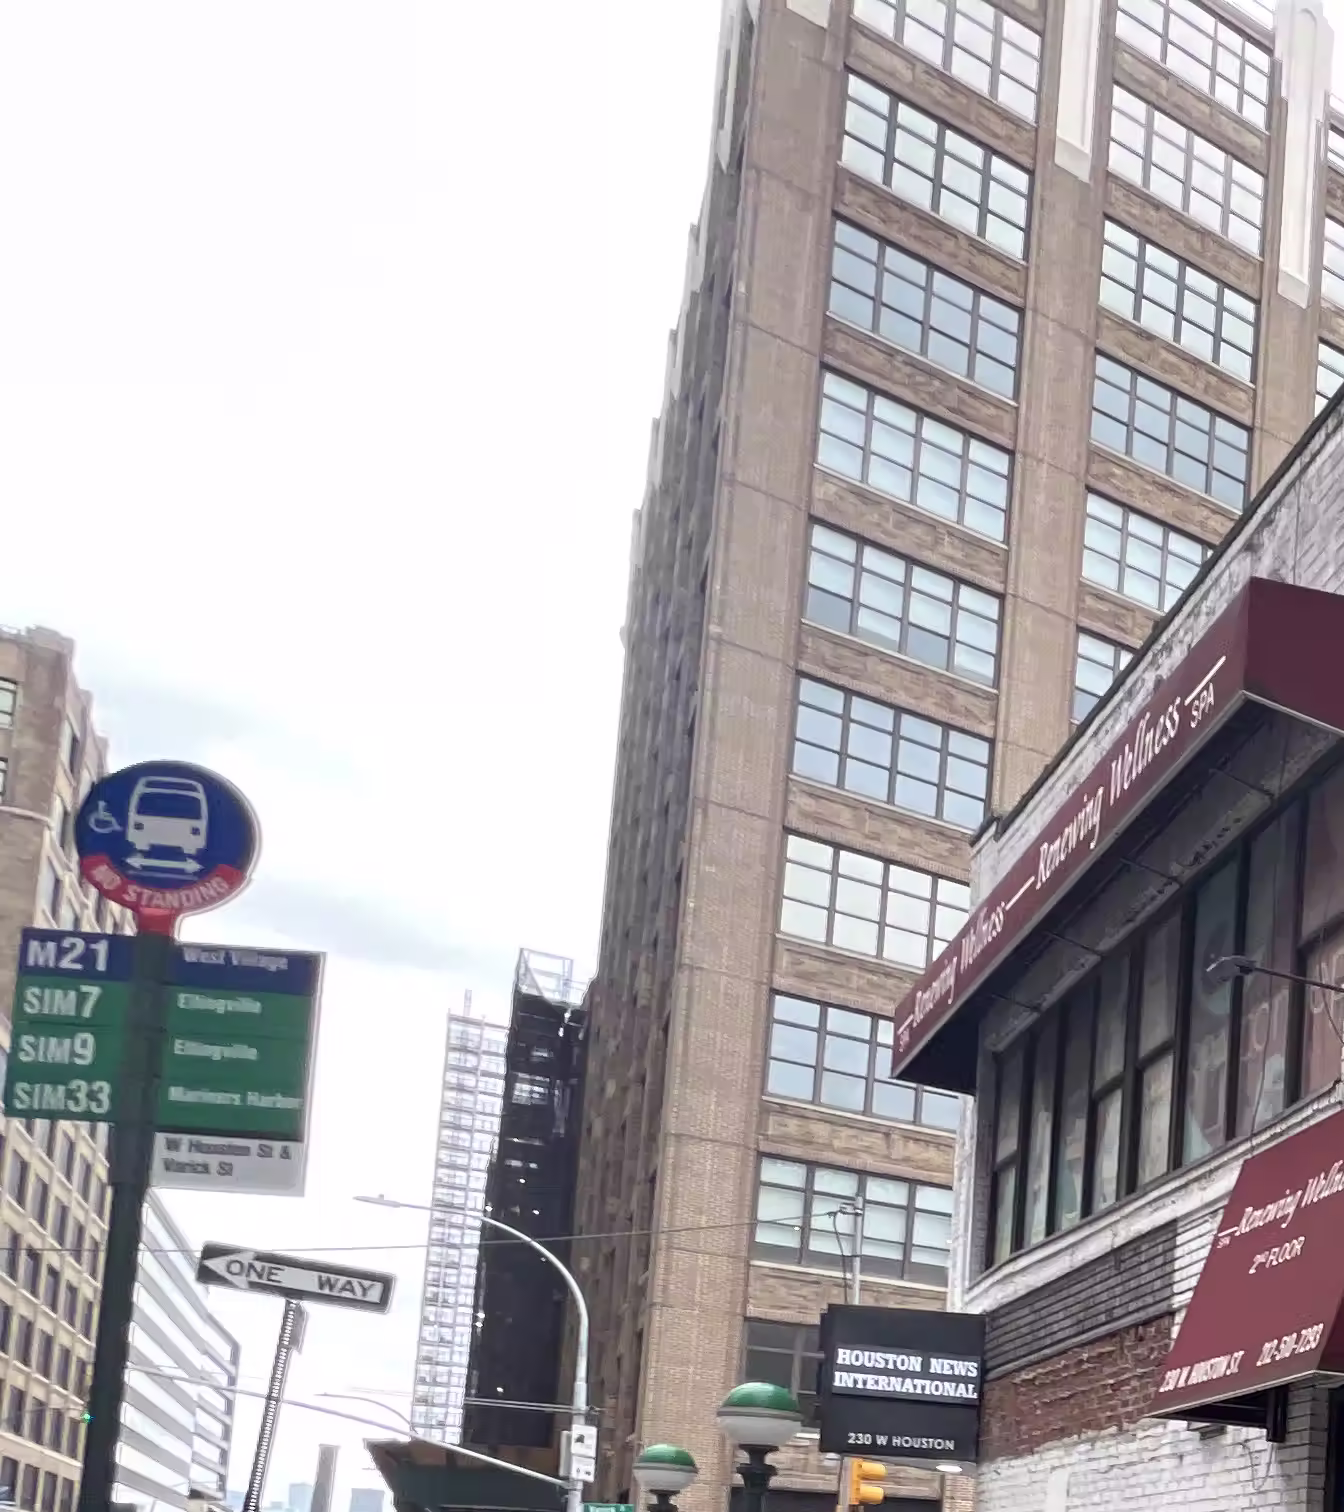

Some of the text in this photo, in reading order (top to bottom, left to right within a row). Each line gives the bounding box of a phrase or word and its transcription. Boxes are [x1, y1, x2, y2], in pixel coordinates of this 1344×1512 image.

[1190, 682, 1214, 728] SPA
[1036, 696, 1181, 889] Renewing Wellness
[122, 876, 229, 908] STANDING
[26, 937, 109, 972] M21
[23, 984, 102, 1018] SIM7
[18, 1032, 95, 1065] SIM9
[13, 1079, 111, 1114] SIM33
[1264, 1236, 1306, 1268] FLOOR
[226, 1259, 376, 1299] ONE WAY
[836, 1348, 978, 1378] HOUSTON NEWS
[833, 1370, 978, 1399] INTERNATIONAL
[847, 1432, 955, 1451] 230 W HOUSTON
